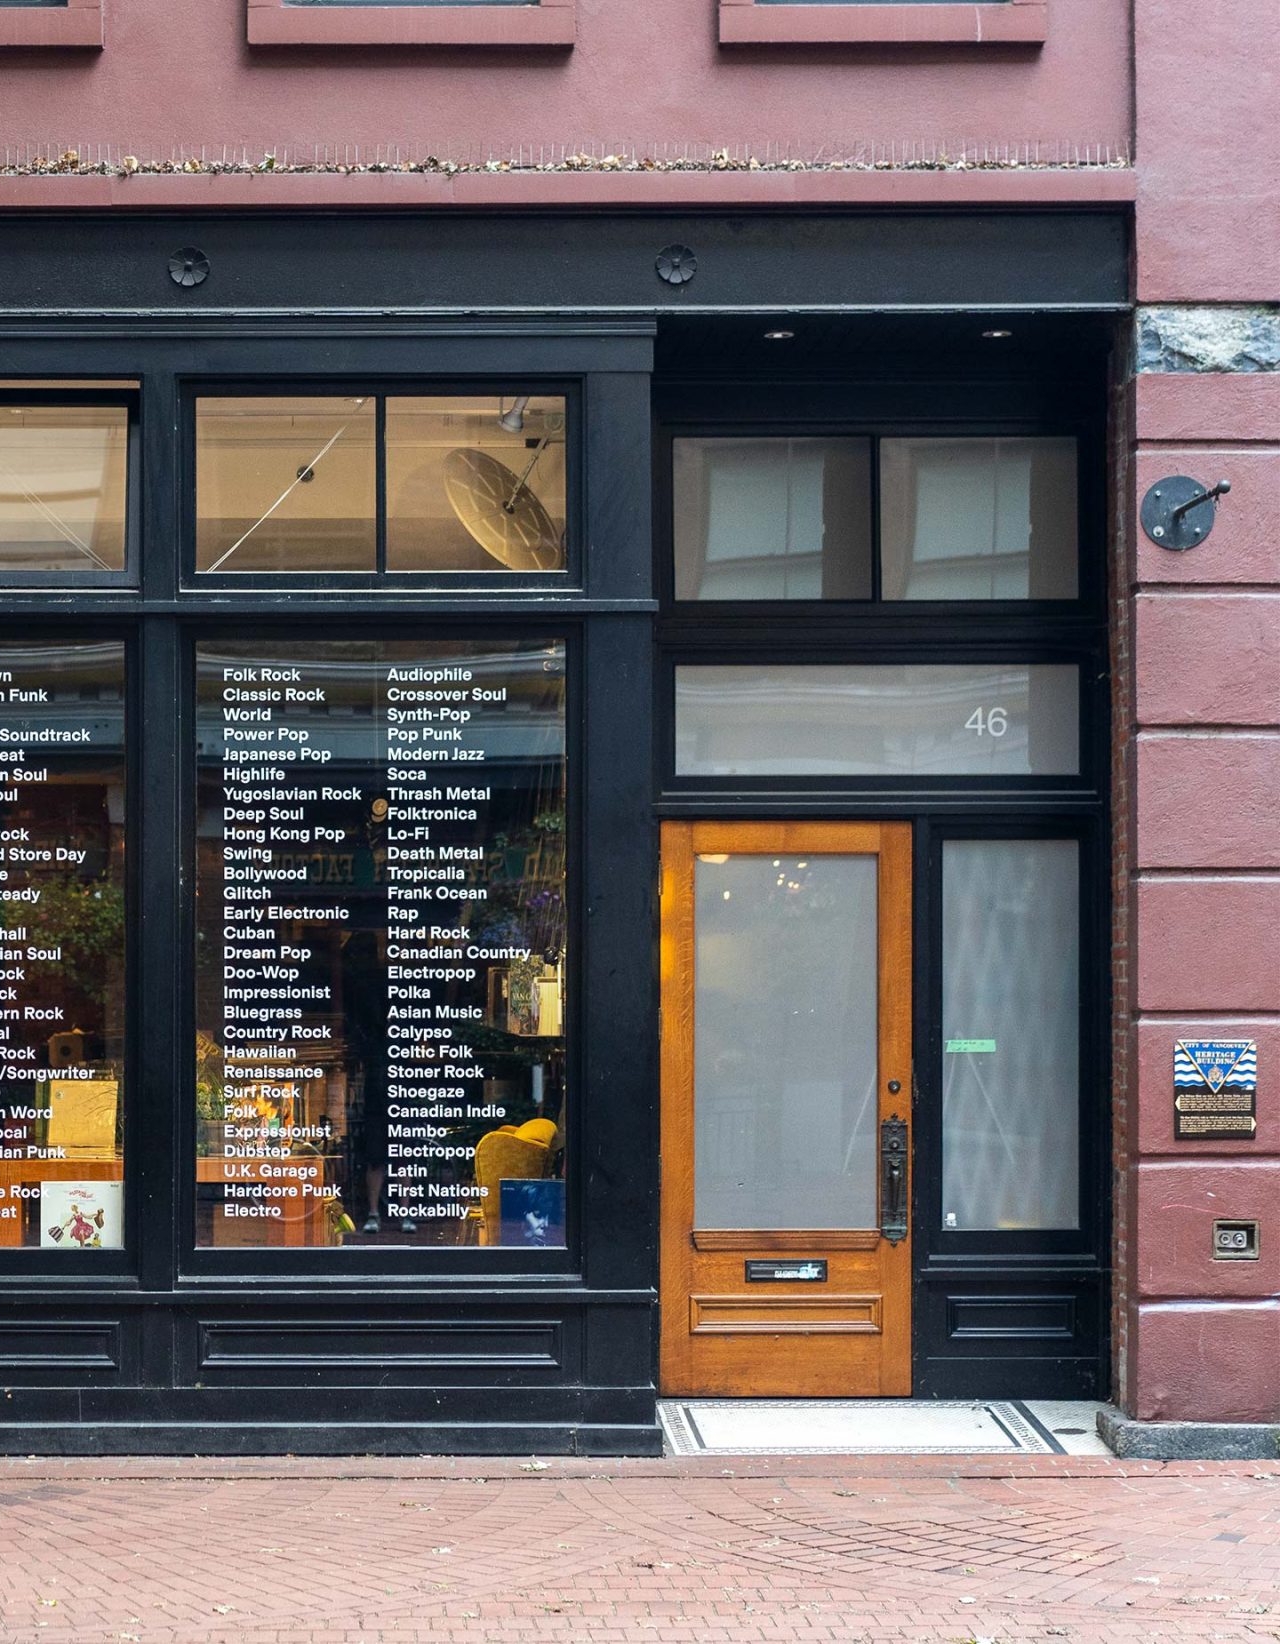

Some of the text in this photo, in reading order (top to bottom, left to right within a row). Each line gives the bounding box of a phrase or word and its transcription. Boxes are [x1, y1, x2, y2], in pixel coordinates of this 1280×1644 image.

[223, 668, 301, 682] Folk Rock
[223, 707, 271, 721] World
[965, 707, 1007, 736] 46
[0, 728, 91, 742] Soundtrack
[387, 727, 462, 744] Pop Punk
[222, 747, 332, 764] Japanese Pop
[12, 768, 47, 782] Soul
[387, 767, 426, 781] Soca
[223, 787, 362, 804] Yugoslavian Rock
[388, 807, 477, 820] Folktronica
[223, 826, 346, 843] Hong Kong Pop
[8, 847, 52, 861] Store
[56, 847, 86, 864] Day
[387, 846, 483, 860] Death Metal
[223, 866, 307, 883] Bollywood
[388, 886, 487, 900] Frank Ocean
[388, 926, 470, 940] Hard Rock
[223, 945, 311, 962] Dream Pop
[388, 965, 476, 982] Electropop
[224, 985, 331, 1002] Impressionist
[24, 1006, 64, 1020] Rock
[223, 1025, 332, 1042] Country Rock
[387, 1045, 473, 1059] Celtic Folk
[224, 1065, 323, 1079] Renaissance
[387, 1084, 465, 1101] Shoegaze
[224, 1103, 258, 1119] Folk
[388, 1124, 448, 1138] Mambo
[224, 1144, 291, 1160] Dubstep
[388, 1164, 427, 1178] Latin
[388, 1203, 470, 1220] Rockabilly
